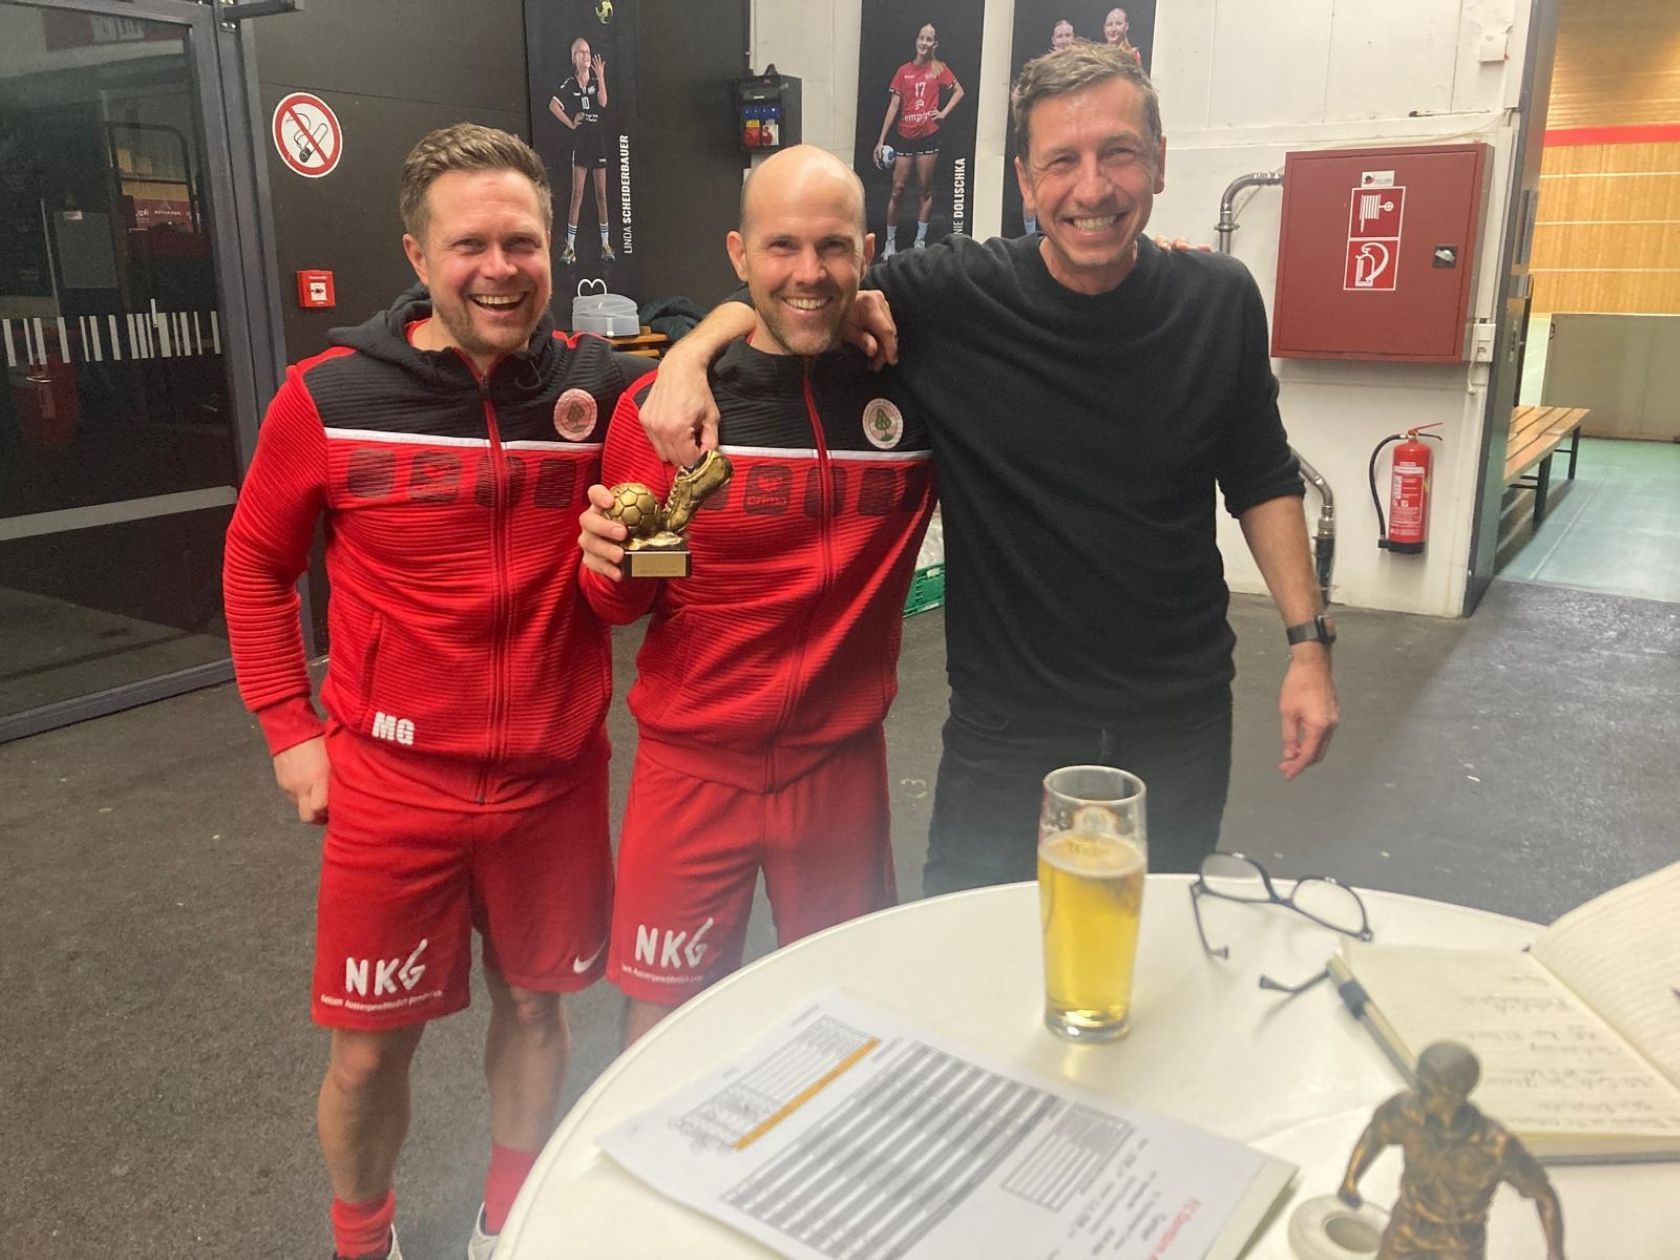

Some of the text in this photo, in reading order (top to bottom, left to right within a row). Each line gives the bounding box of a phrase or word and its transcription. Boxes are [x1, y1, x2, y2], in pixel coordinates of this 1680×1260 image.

[915, 82, 926, 97] 17
[619, 134, 633, 254] LINDA SCHEIDERBAUER
[953, 157, 966, 218] DOLISCHKA
[371, 711, 415, 746] MG
[345, 938, 428, 997] NKG
[635, 917, 714, 969] NKG
